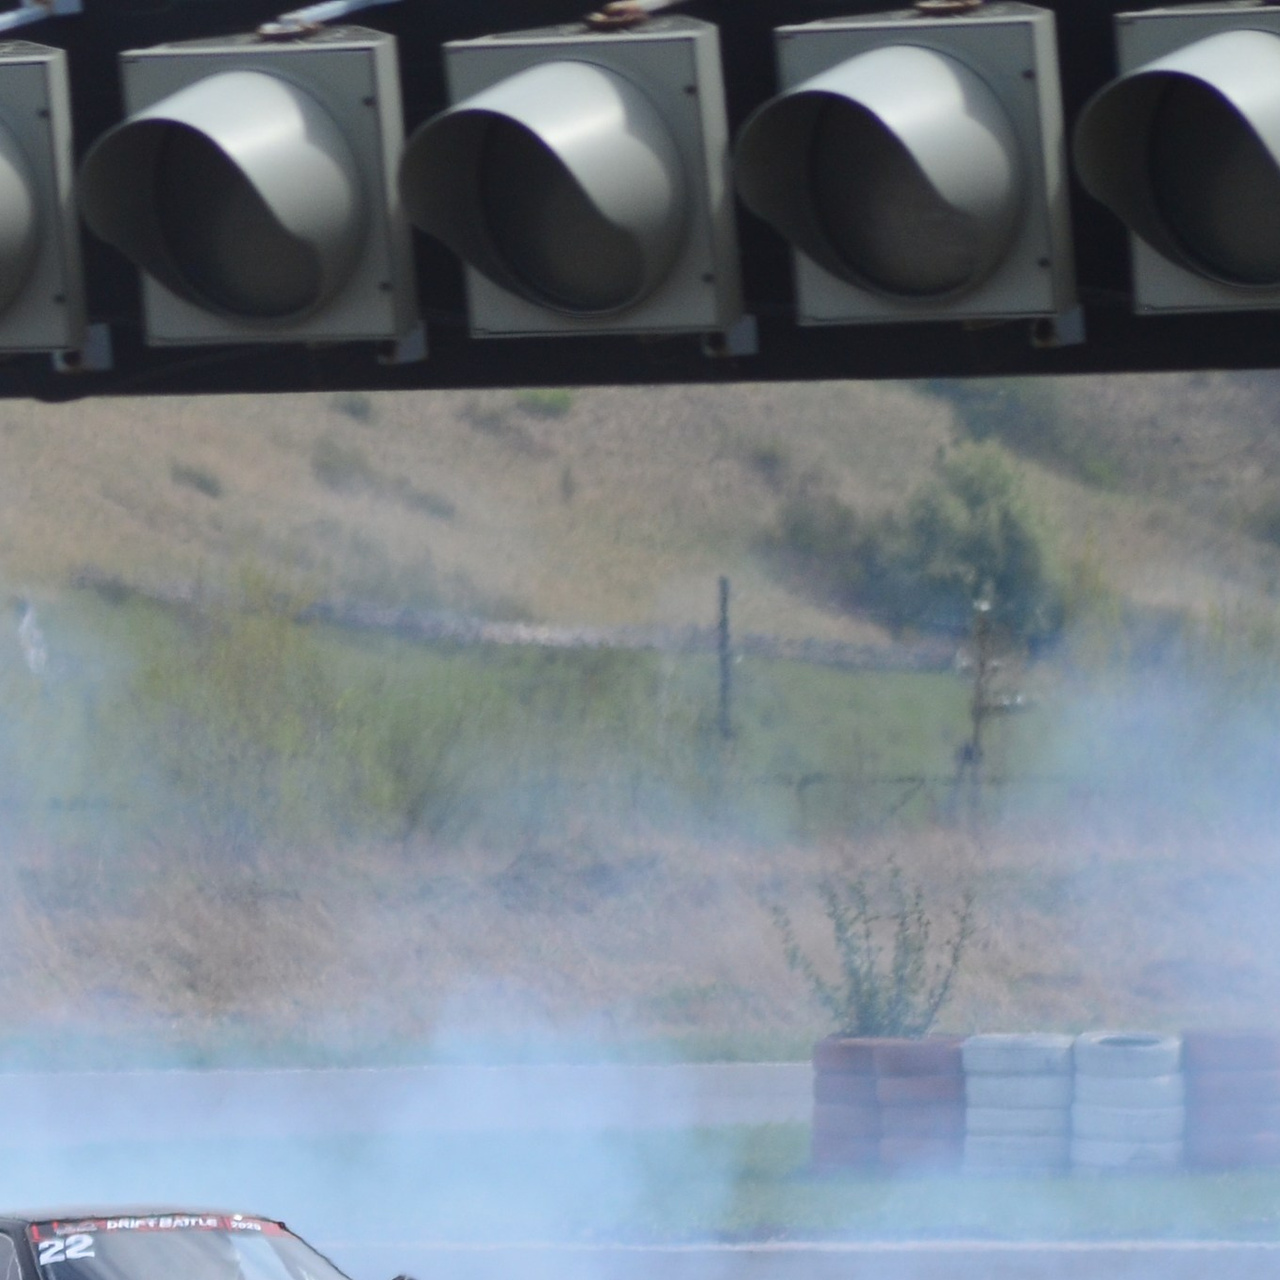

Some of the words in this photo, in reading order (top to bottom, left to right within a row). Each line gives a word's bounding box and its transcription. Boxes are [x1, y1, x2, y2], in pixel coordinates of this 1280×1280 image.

[106, 1217, 158, 1230] DRIFT
[159, 1215, 218, 1229] BATTLE
[38, 1233, 95, 1266] 22
